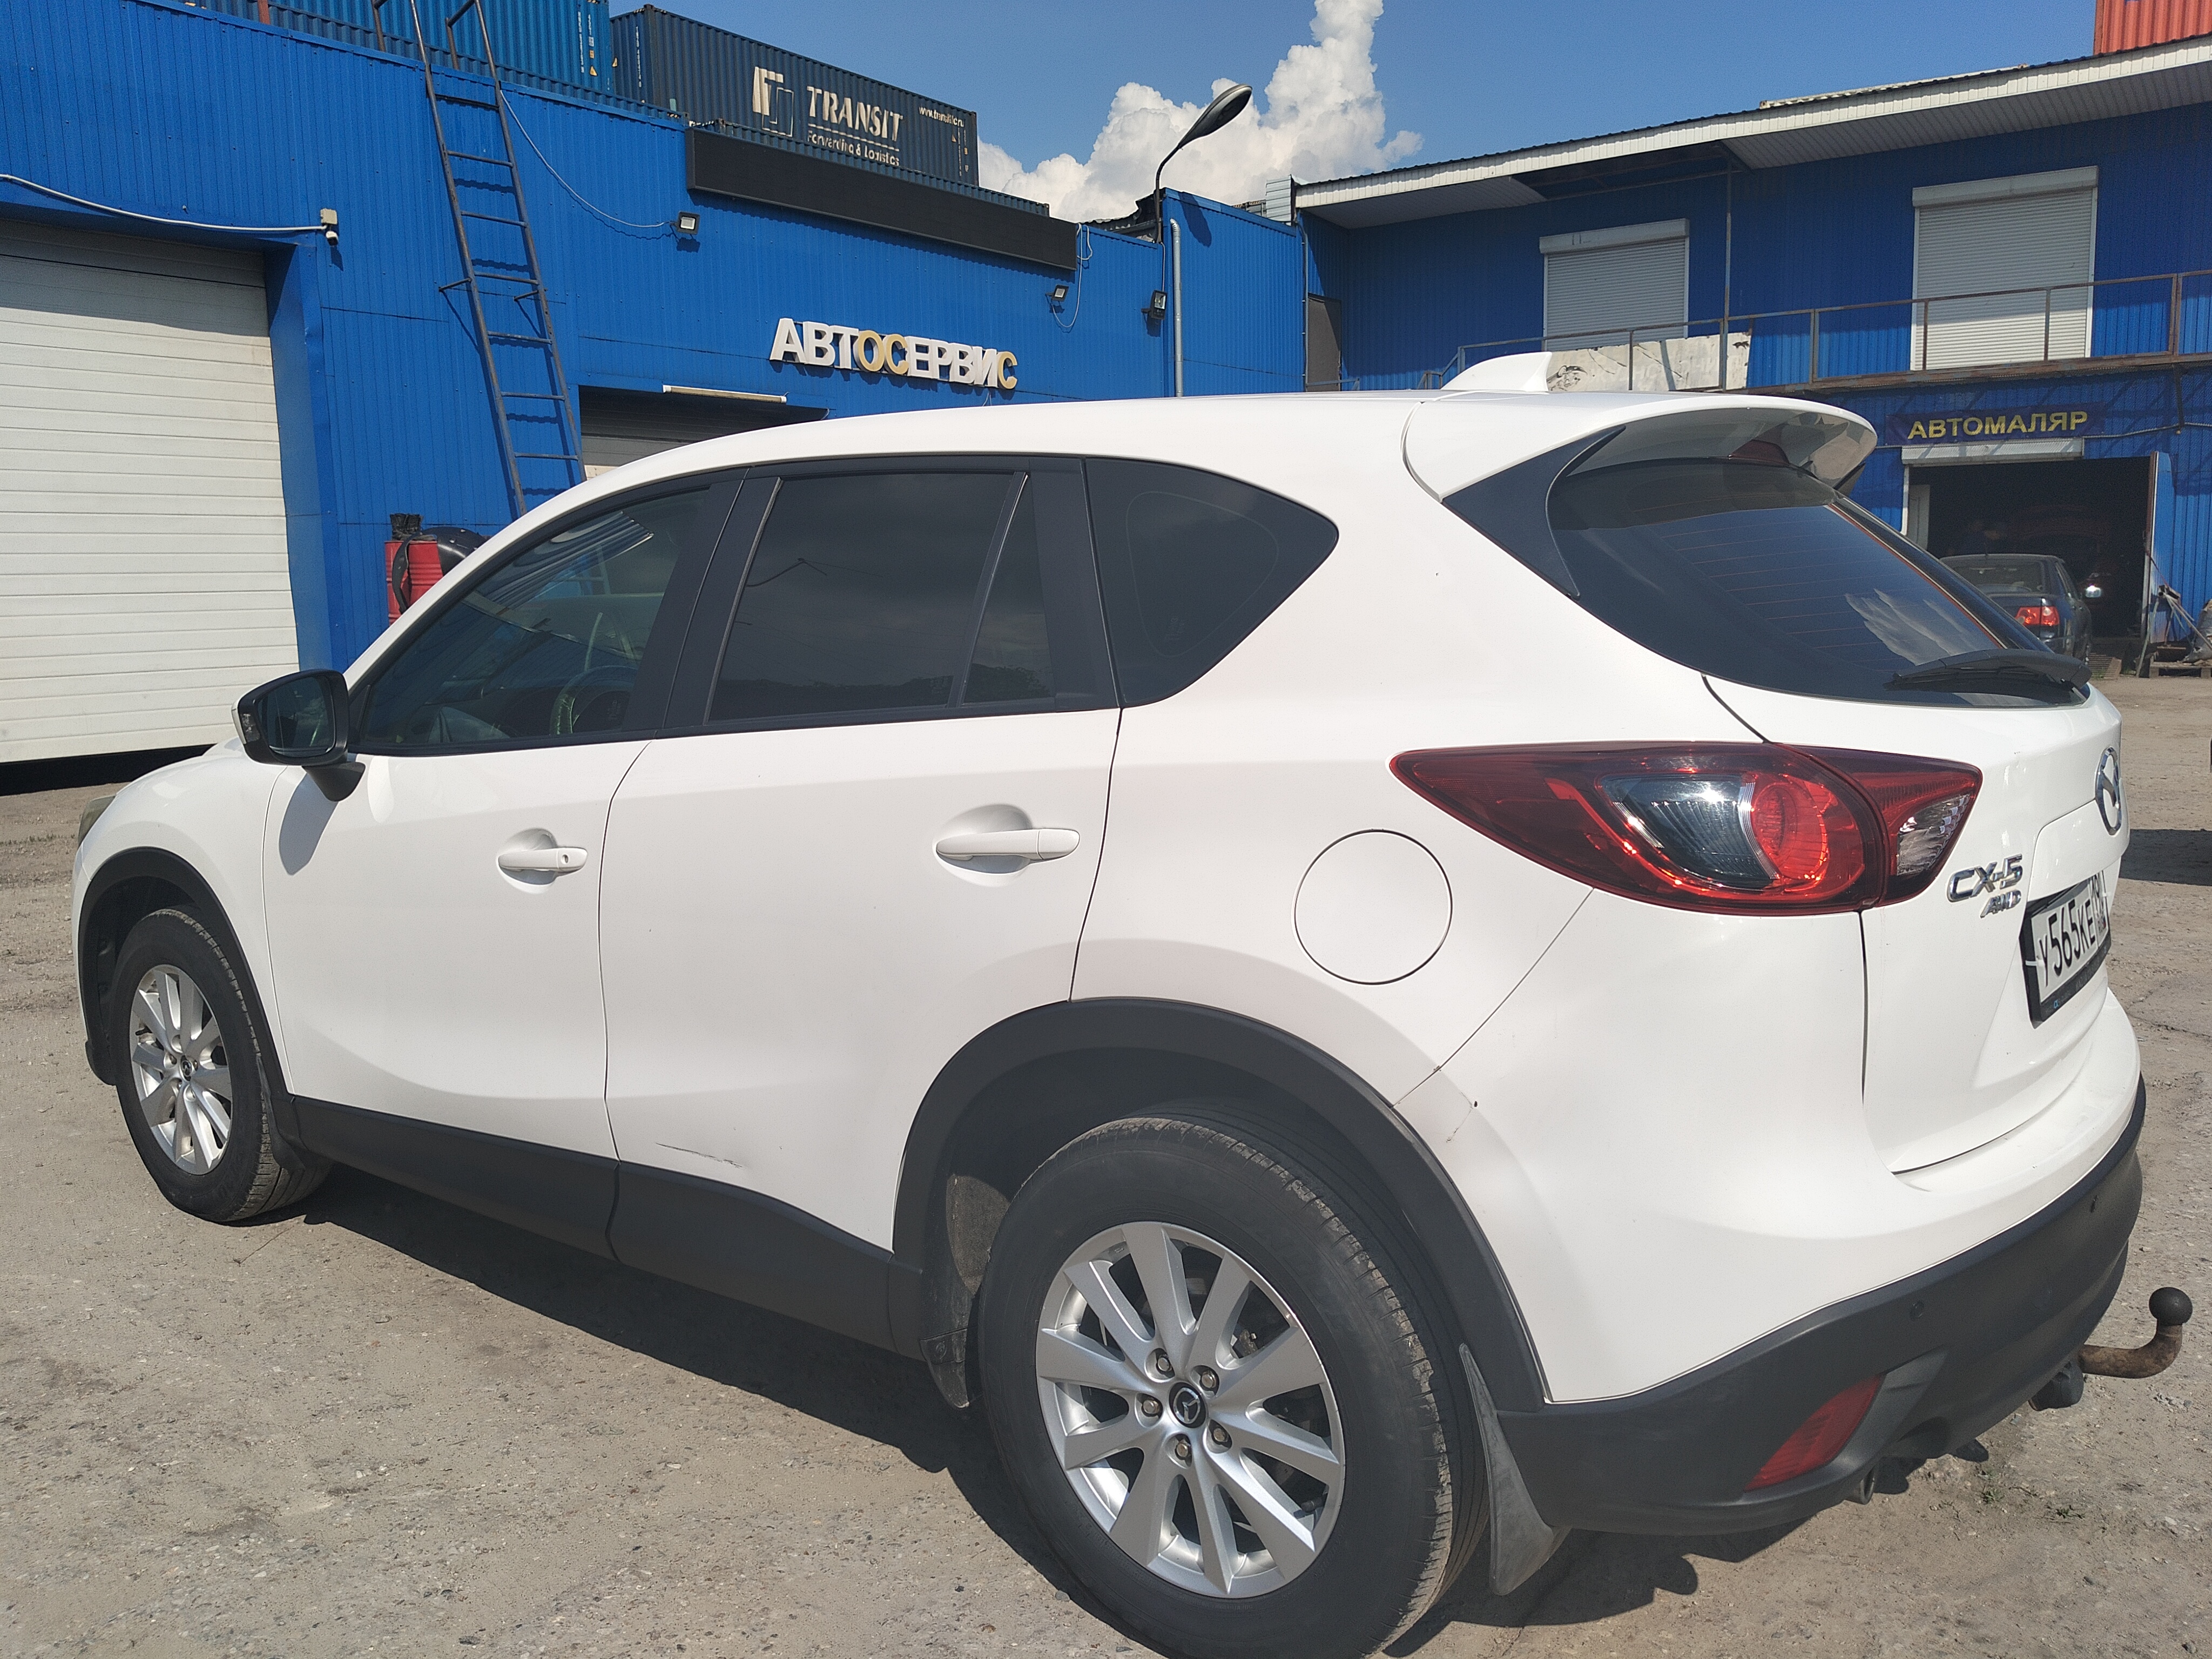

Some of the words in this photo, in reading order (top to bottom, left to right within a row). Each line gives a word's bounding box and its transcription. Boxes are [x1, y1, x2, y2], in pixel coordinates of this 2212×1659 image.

[807, 86, 903, 141] TRANSIT
[807, 130, 854, 154] Forwarding
[855, 143, 861, 156] &
[865, 145, 900, 166] Logistics
[770, 318, 1017, 389] АВТОСЕРВИС
[1907, 411, 2088, 440] АВТОМАЛЯР
[1947, 853, 2023, 903] CX-5
[1980, 889, 2021, 919] AWD
